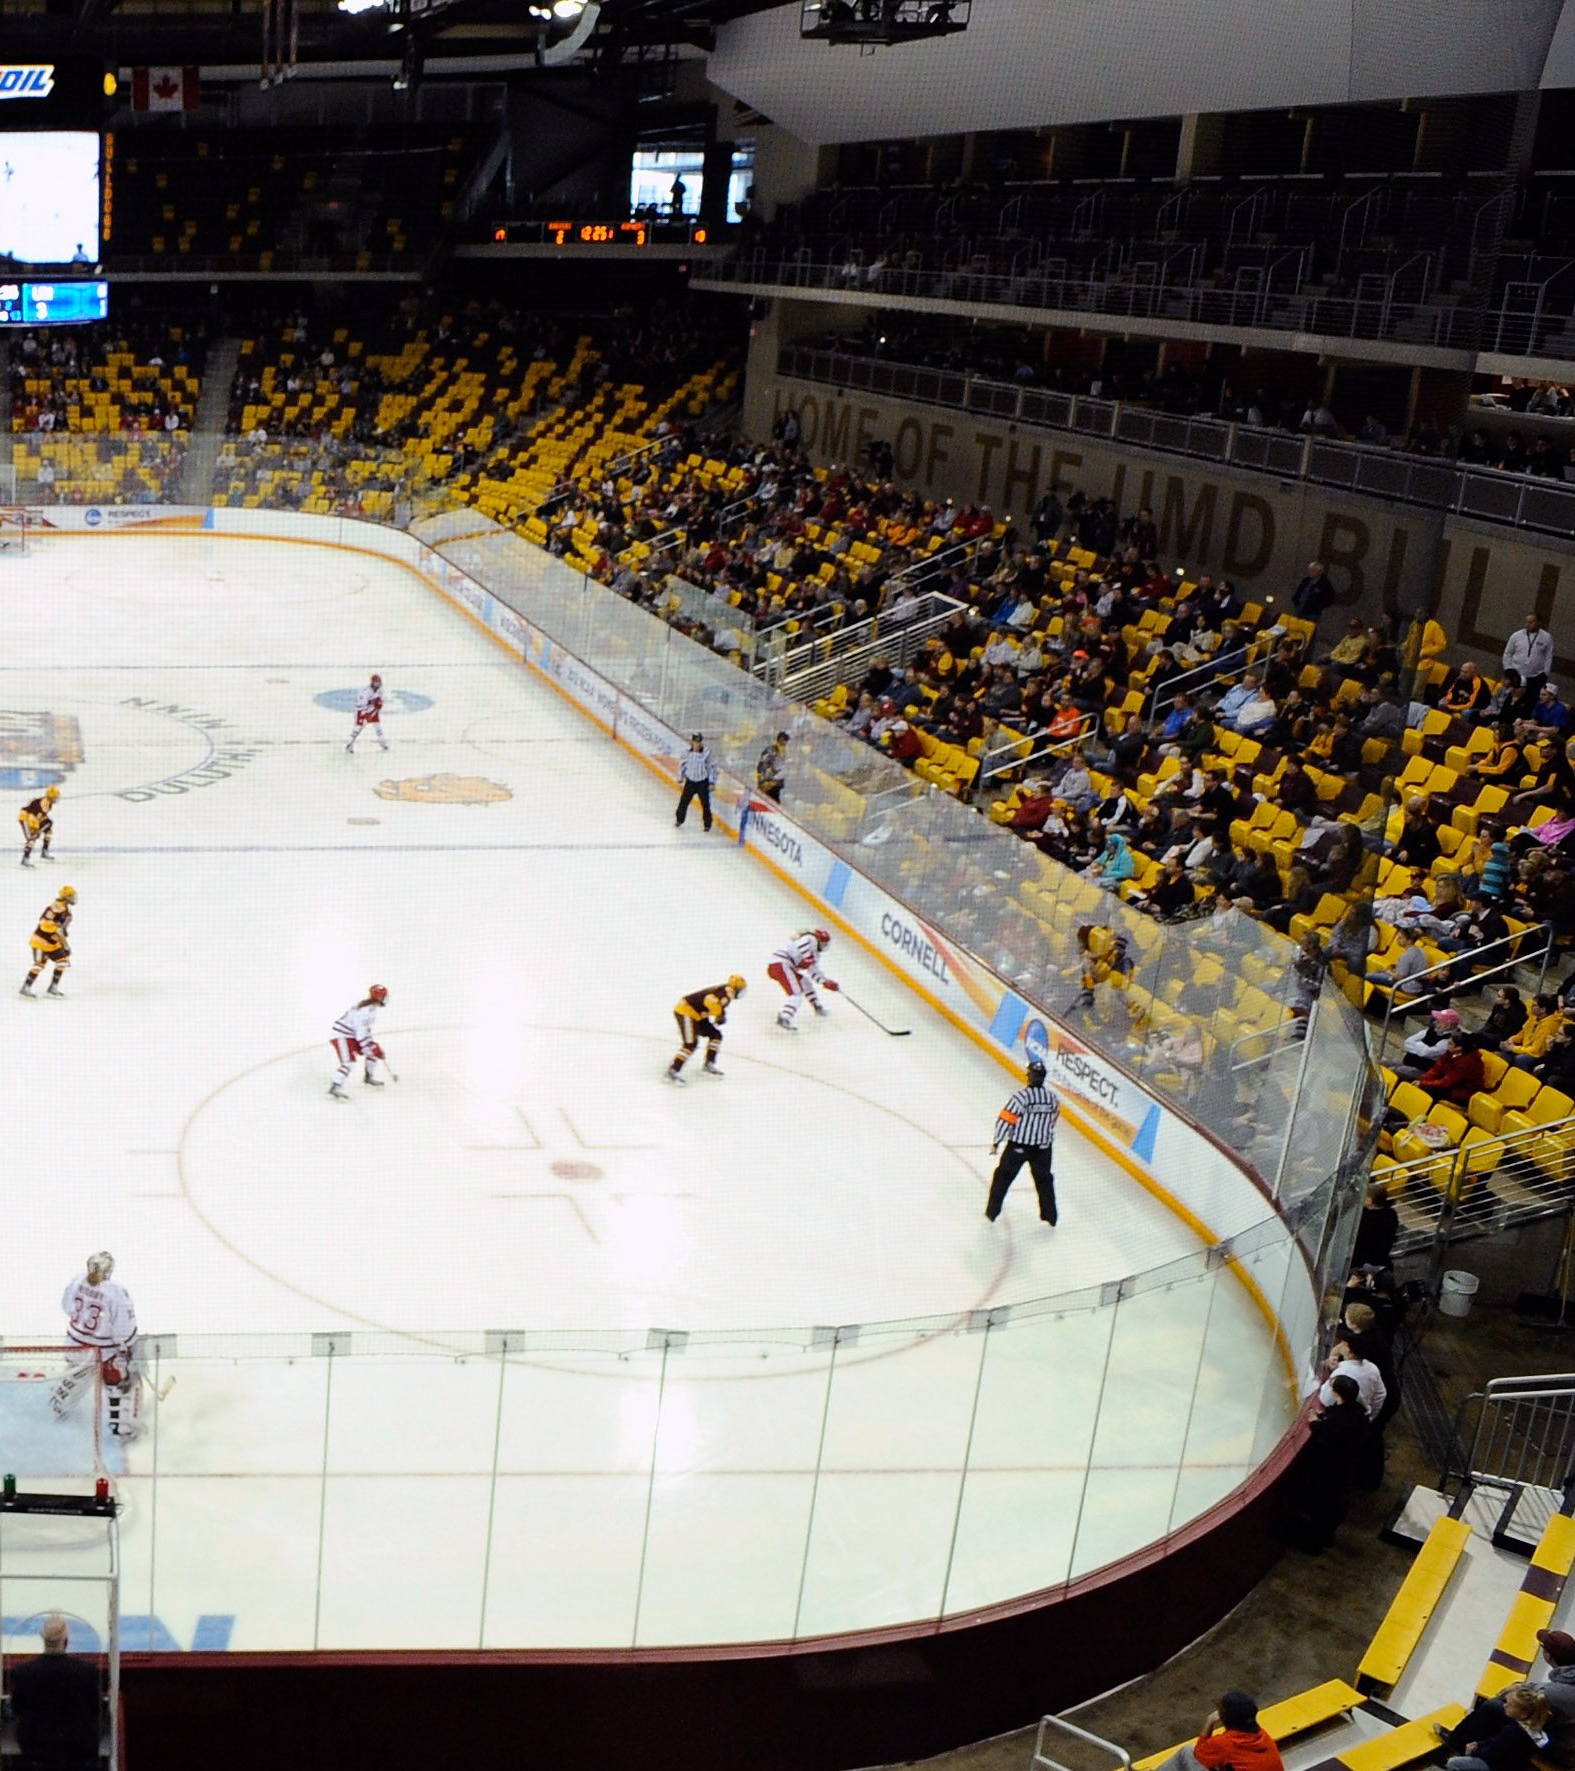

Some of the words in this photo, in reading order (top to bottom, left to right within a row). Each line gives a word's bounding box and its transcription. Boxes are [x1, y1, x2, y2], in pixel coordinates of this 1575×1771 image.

[36, 302, 49, 319] 3
[774, 389, 876, 468] HOME
[897, 418, 953, 486] OF
[975, 431, 1084, 514] THE
[881, 911, 950, 986] CORNELL
